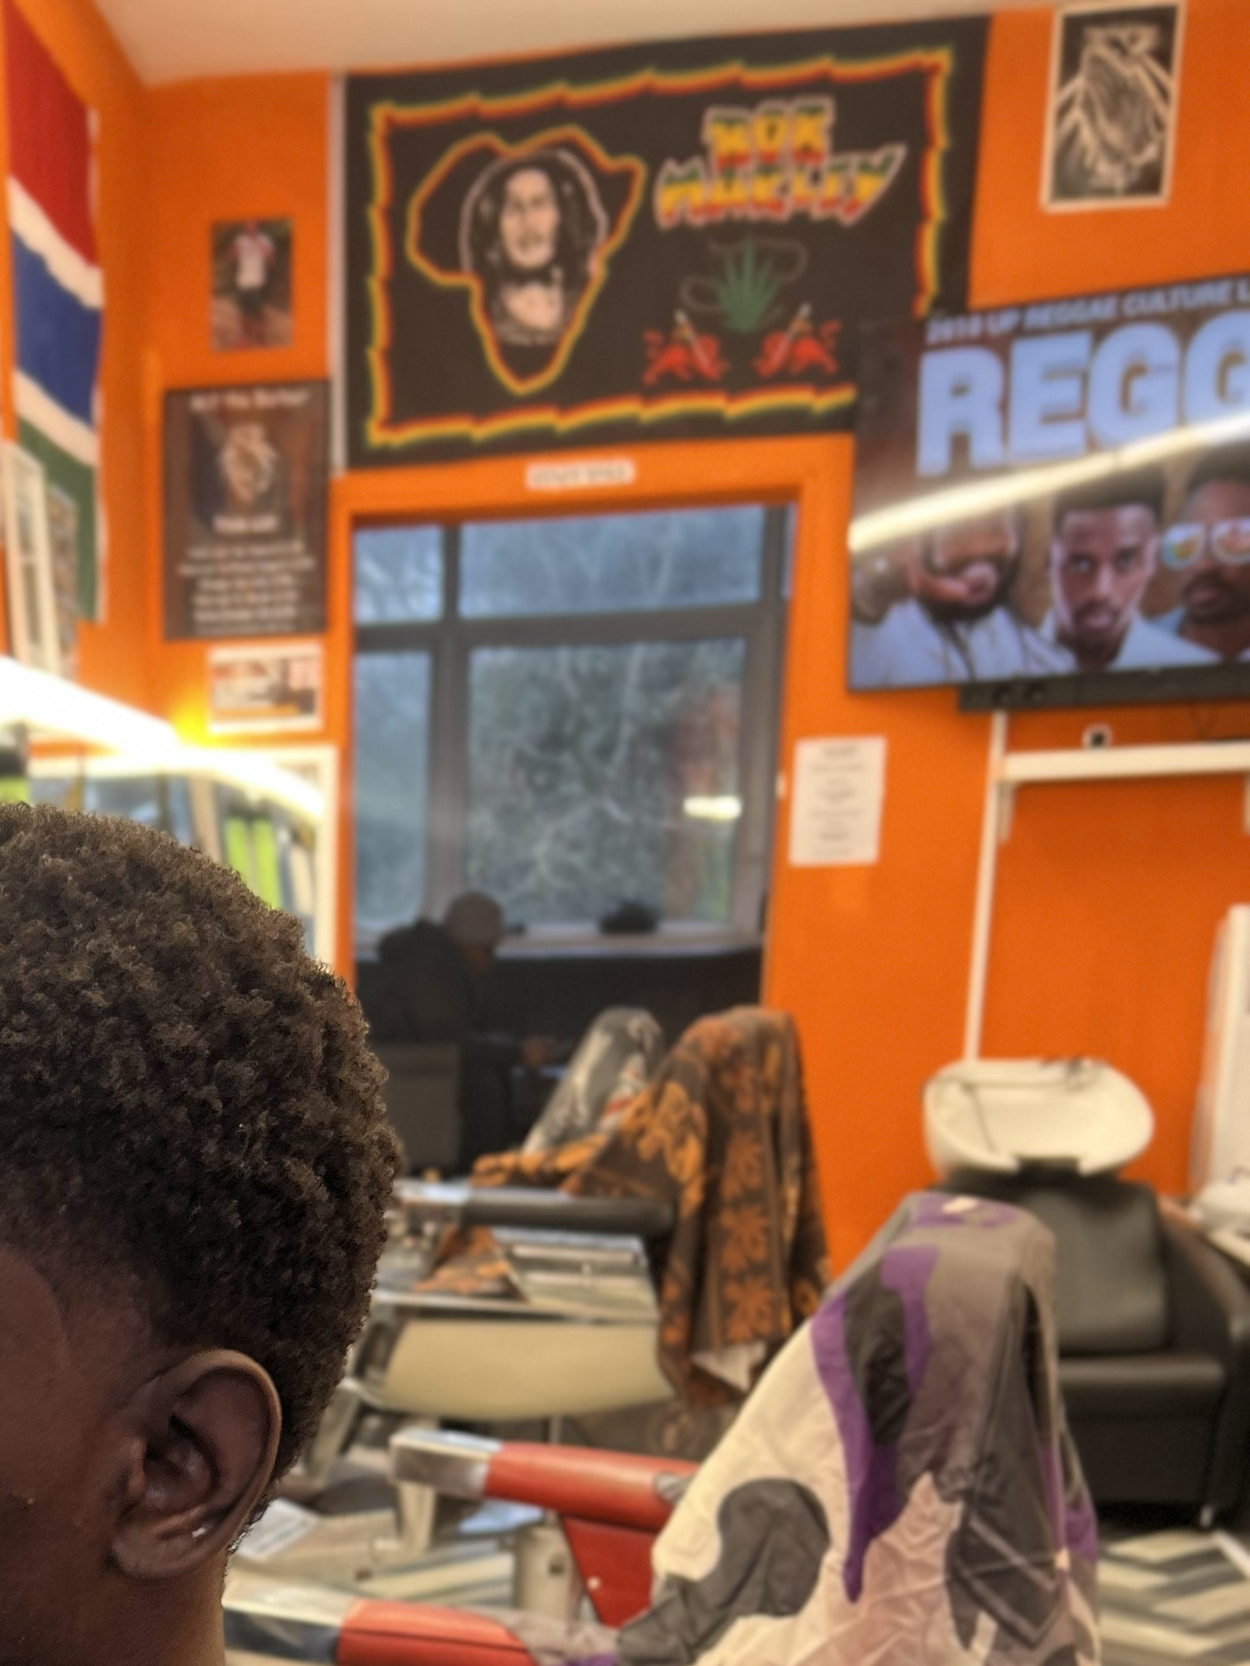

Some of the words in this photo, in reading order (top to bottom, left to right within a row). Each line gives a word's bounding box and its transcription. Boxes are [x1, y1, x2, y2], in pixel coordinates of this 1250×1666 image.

[1023, 295, 1117, 330] REGGAE
[1122, 278, 1231, 315] CULTURE
[915, 310, 1250, 477] REGG
